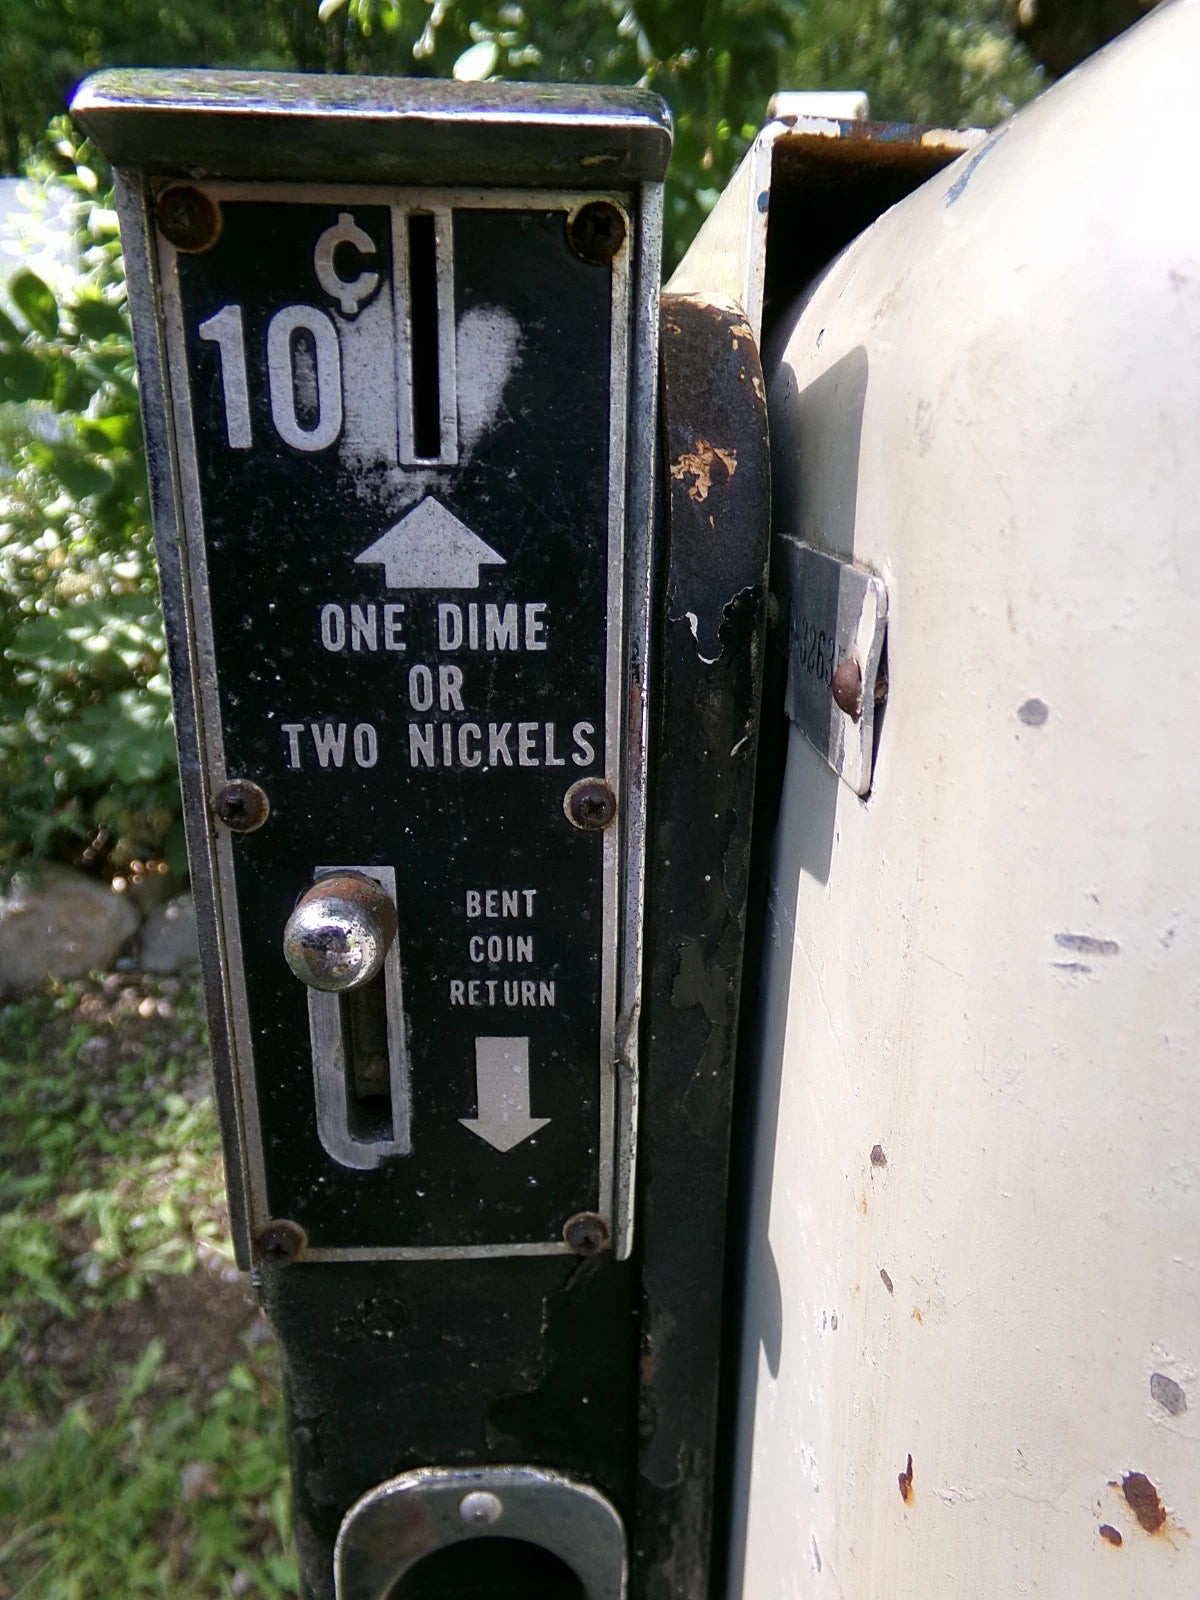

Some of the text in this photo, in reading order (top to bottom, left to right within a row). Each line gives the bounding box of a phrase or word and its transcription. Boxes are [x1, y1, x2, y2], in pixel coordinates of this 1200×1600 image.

[321, 603, 548, 651] ONE DIME
[408, 664, 465, 712] OR
[281, 721, 595, 768] TWO NICKELS
[466, 889, 537, 918] BENT
[469, 935, 533, 963] COIN
[450, 980, 556, 1007] RETURN
